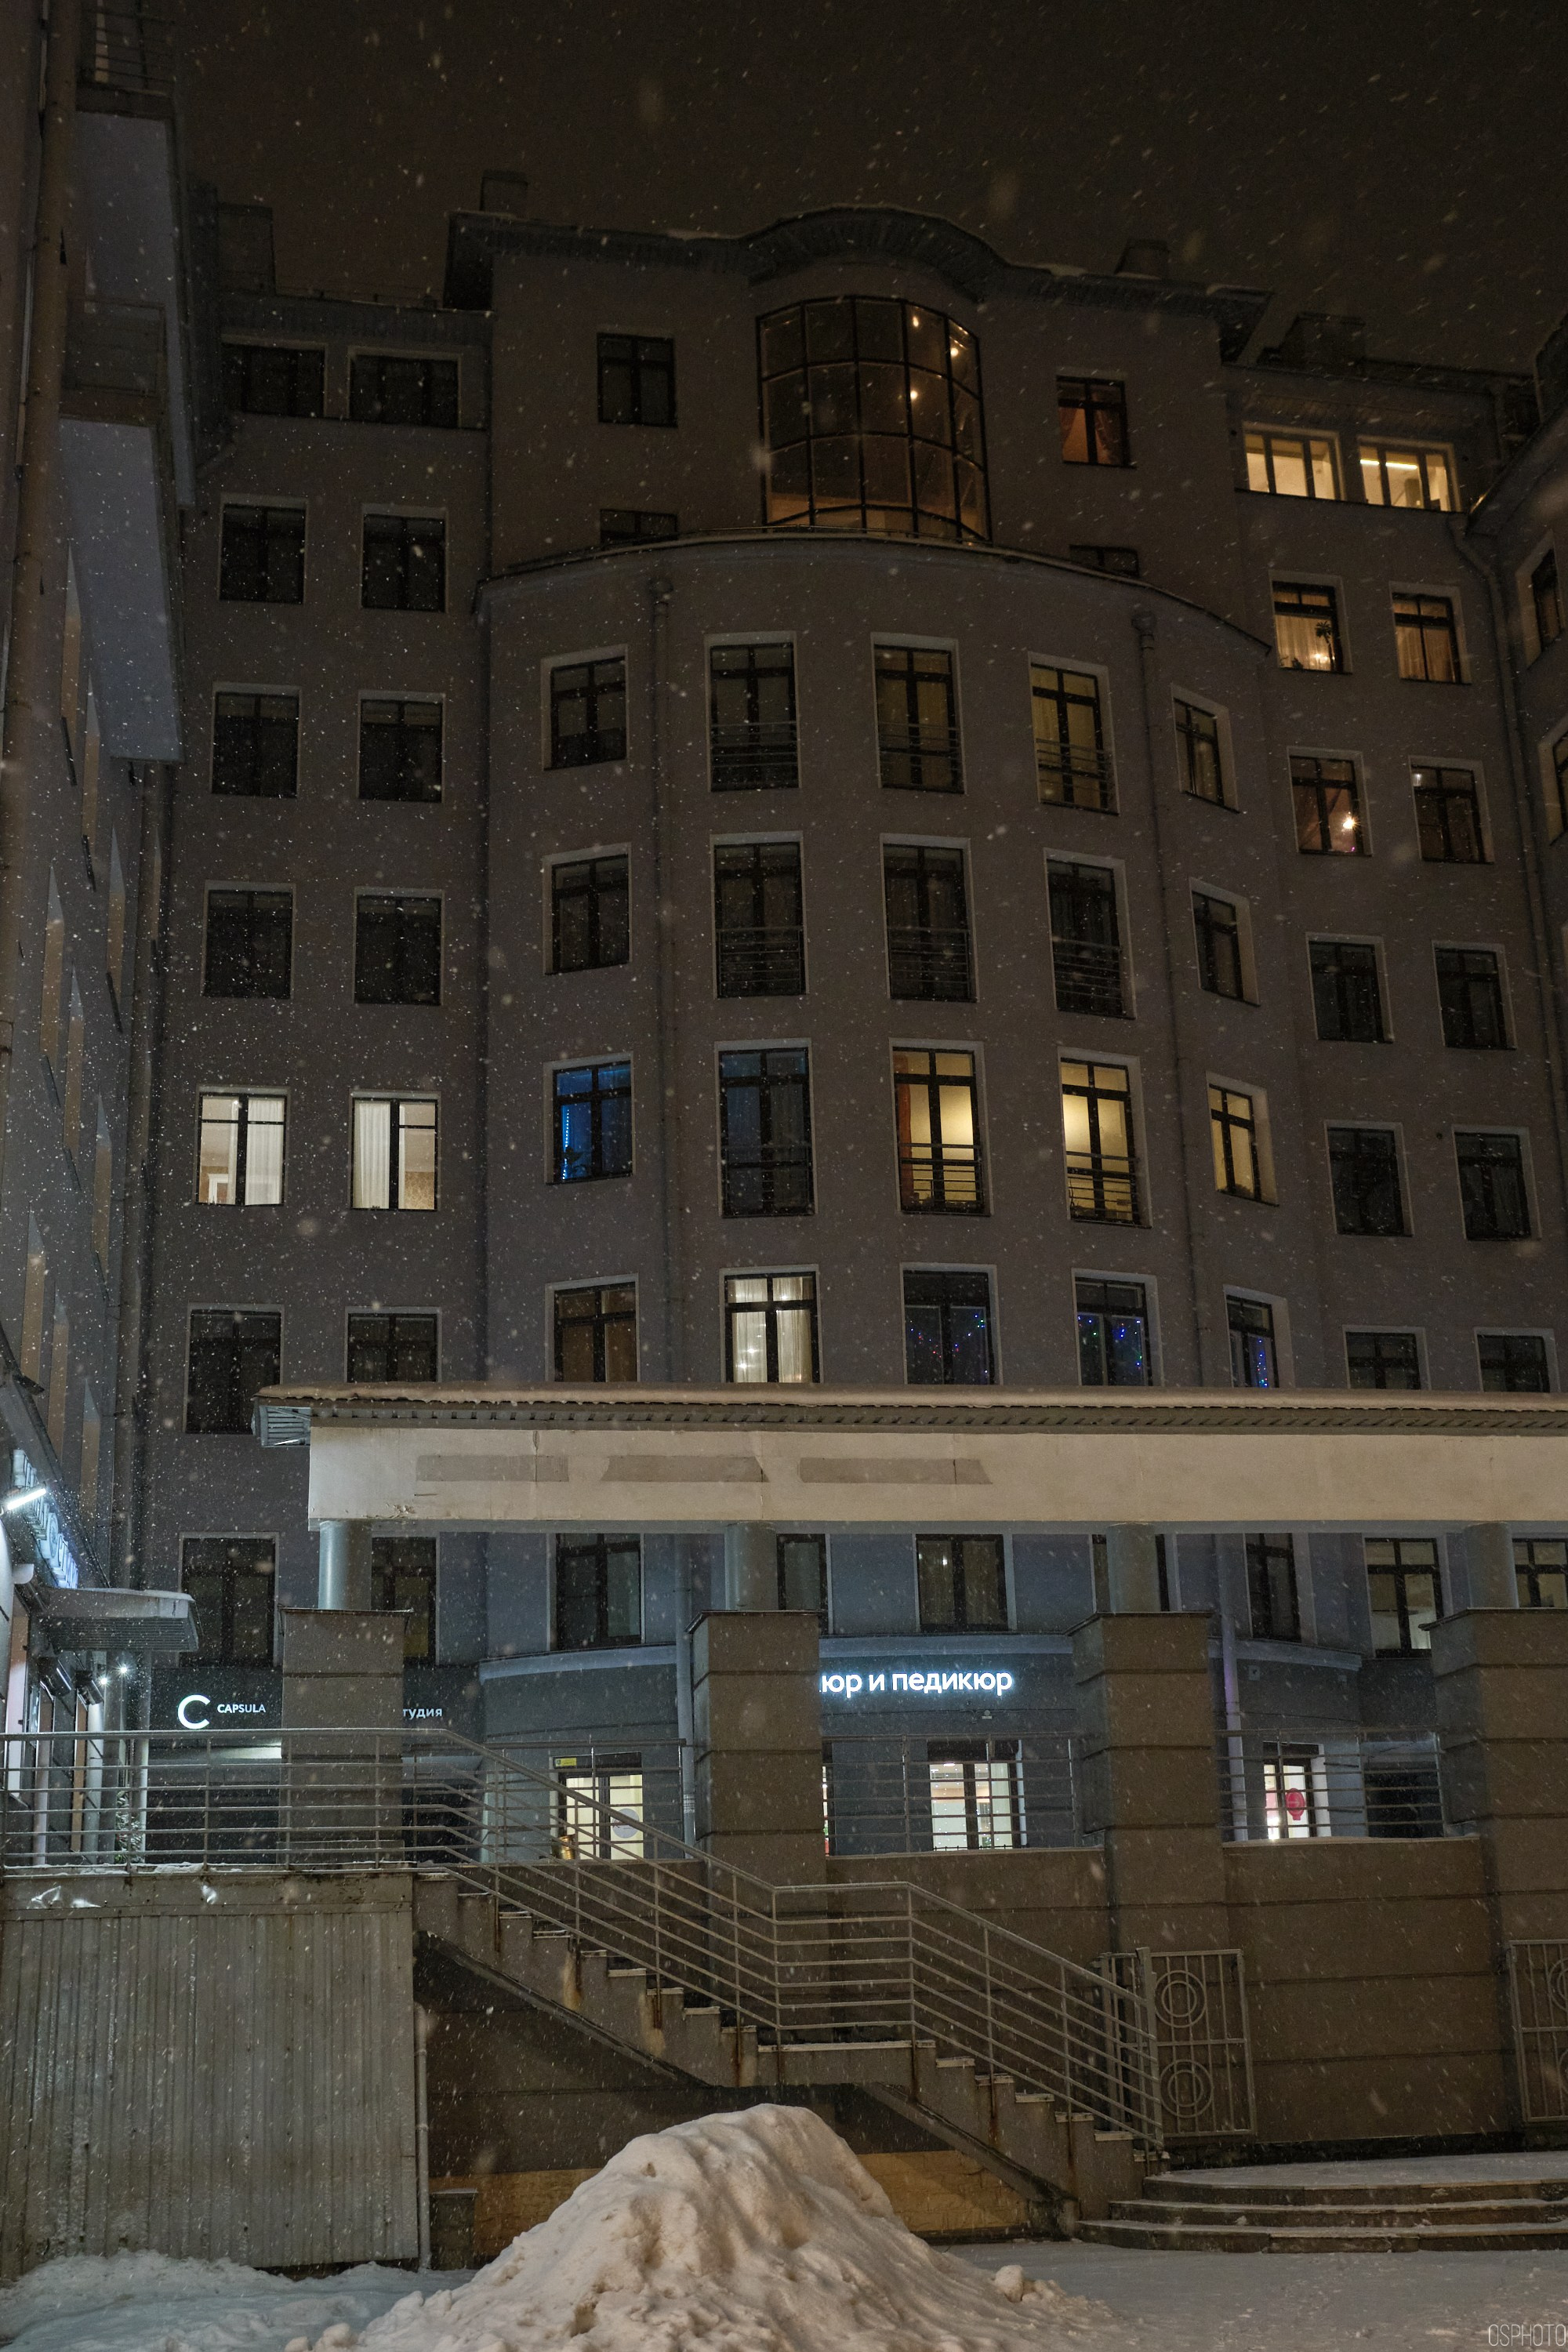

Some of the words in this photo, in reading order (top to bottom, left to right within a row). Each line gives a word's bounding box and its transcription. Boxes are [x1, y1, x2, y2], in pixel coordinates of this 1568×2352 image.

[819, 1672, 862, 1698] юр
[868, 1673, 885, 1692] и
[891, 1671, 1014, 1697] педикюр
[216, 1704, 267, 1714] CAPSULA
[402, 1708, 443, 1720] тудия
